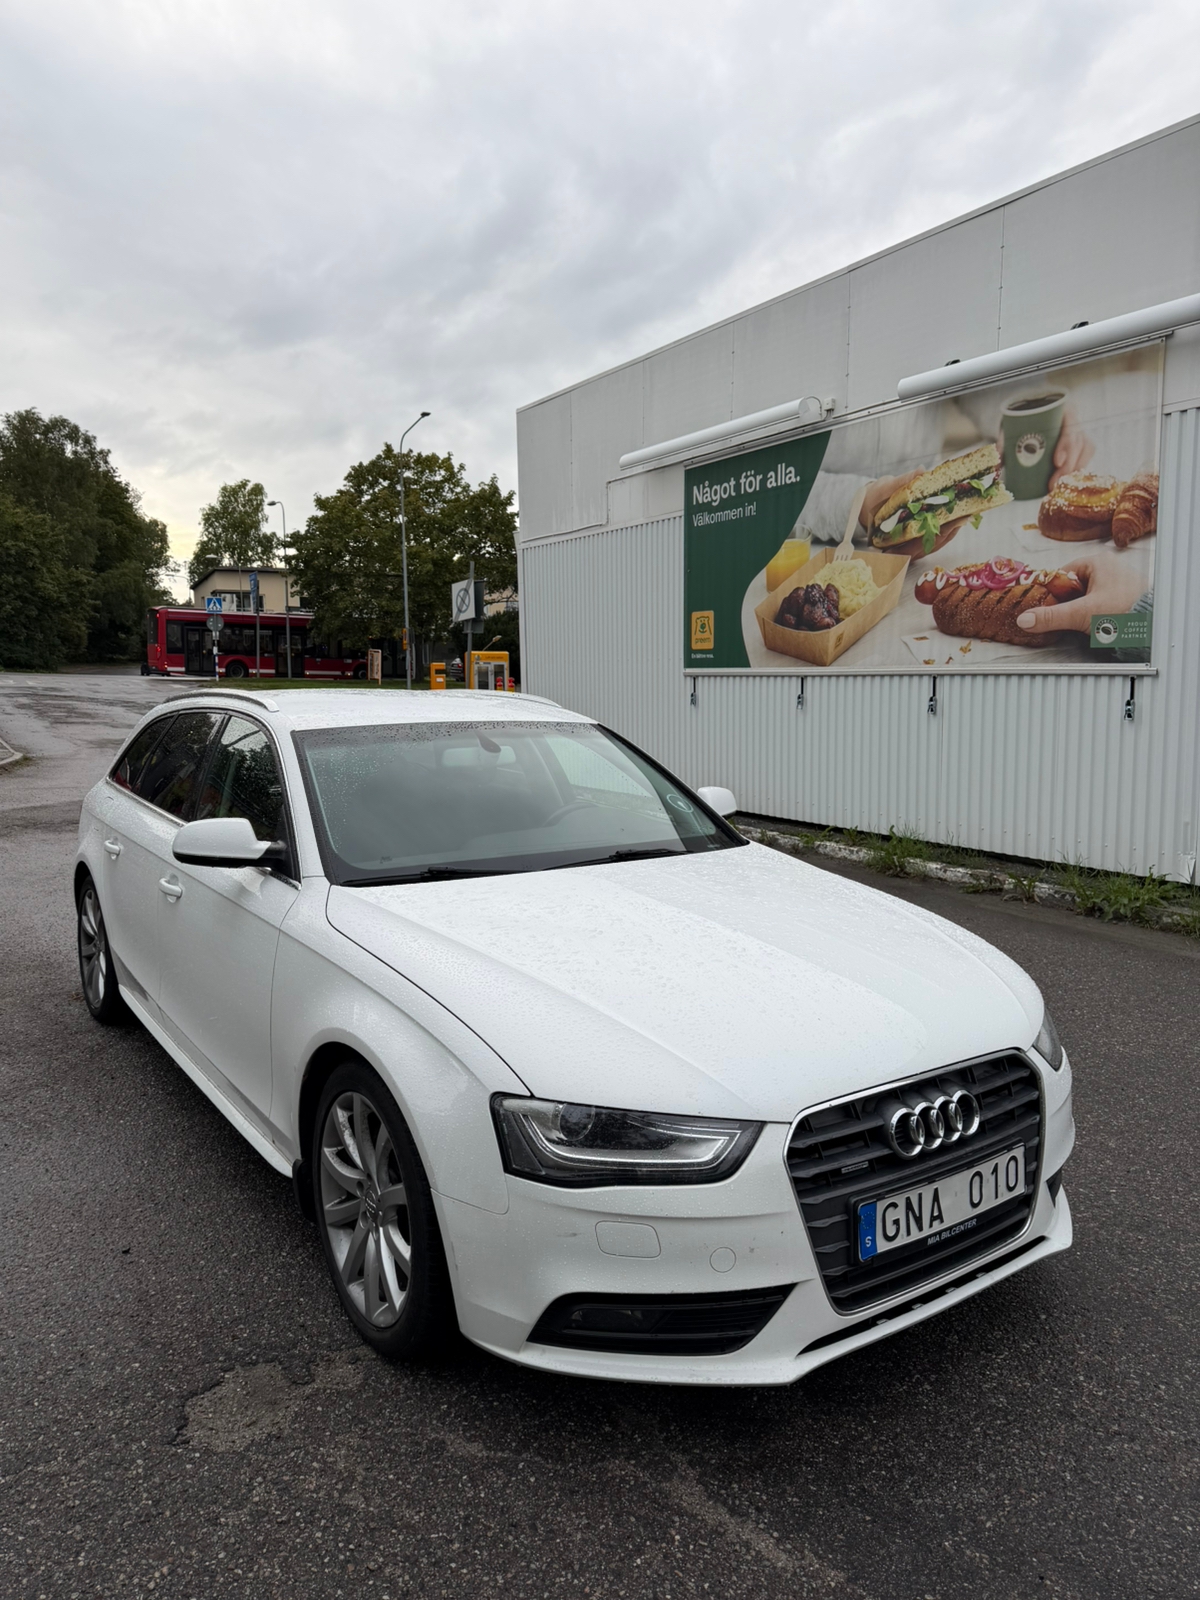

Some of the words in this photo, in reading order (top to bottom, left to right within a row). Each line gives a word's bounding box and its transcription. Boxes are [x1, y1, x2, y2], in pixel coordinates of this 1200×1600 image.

[693, 477, 736, 506] Något
[740, 470, 763, 494] för
[767, 462, 801, 489] alla.
[692, 508, 743, 527] Välkommen
[745, 502, 757, 517] in!
[881, 1187, 945, 1242] GNA
[969, 1155, 1019, 1209] 010
[865, 1235, 872, 1248] S
[927, 1234, 940, 1246] MIA
[941, 1218, 978, 1240] BILCENTER
